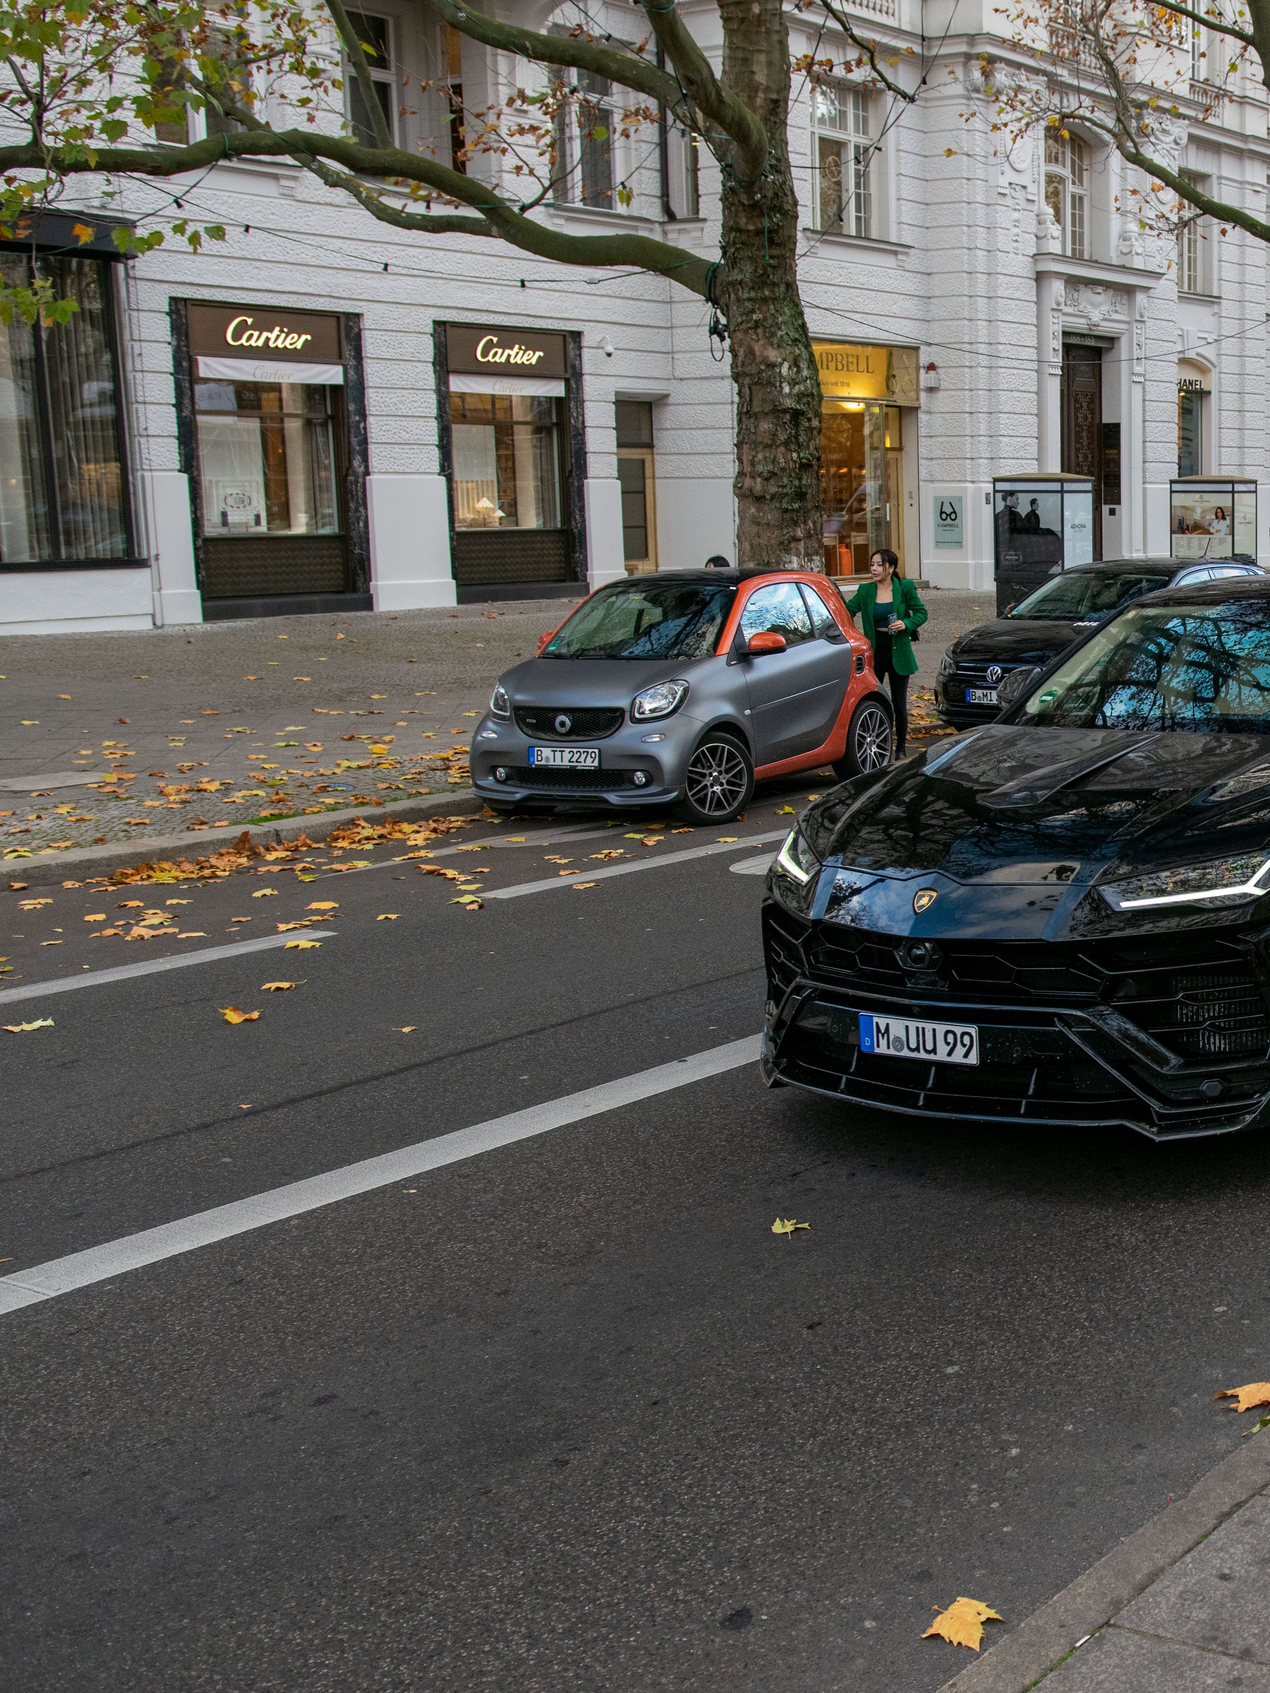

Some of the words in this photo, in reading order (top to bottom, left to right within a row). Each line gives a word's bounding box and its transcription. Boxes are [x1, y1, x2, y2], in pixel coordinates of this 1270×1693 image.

[226, 316, 312, 350] Cartier
[476, 335, 544, 365] Cartier
[817, 351, 875, 374] MPBELL
[252, 365, 294, 381] Cartier
[491, 380, 525, 394] Cartier
[1177, 378, 1204, 390] HANEL
[971, 690, 977, 701] B
[982, 691, 994, 702] MI
[536, 749, 544, 763] B
[551, 749, 566, 763] TT
[568, 751, 597, 764] 2279
[875, 1021, 890, 1050] M
[905, 1024, 937, 1056] UU
[943, 1029, 975, 1059] 99
